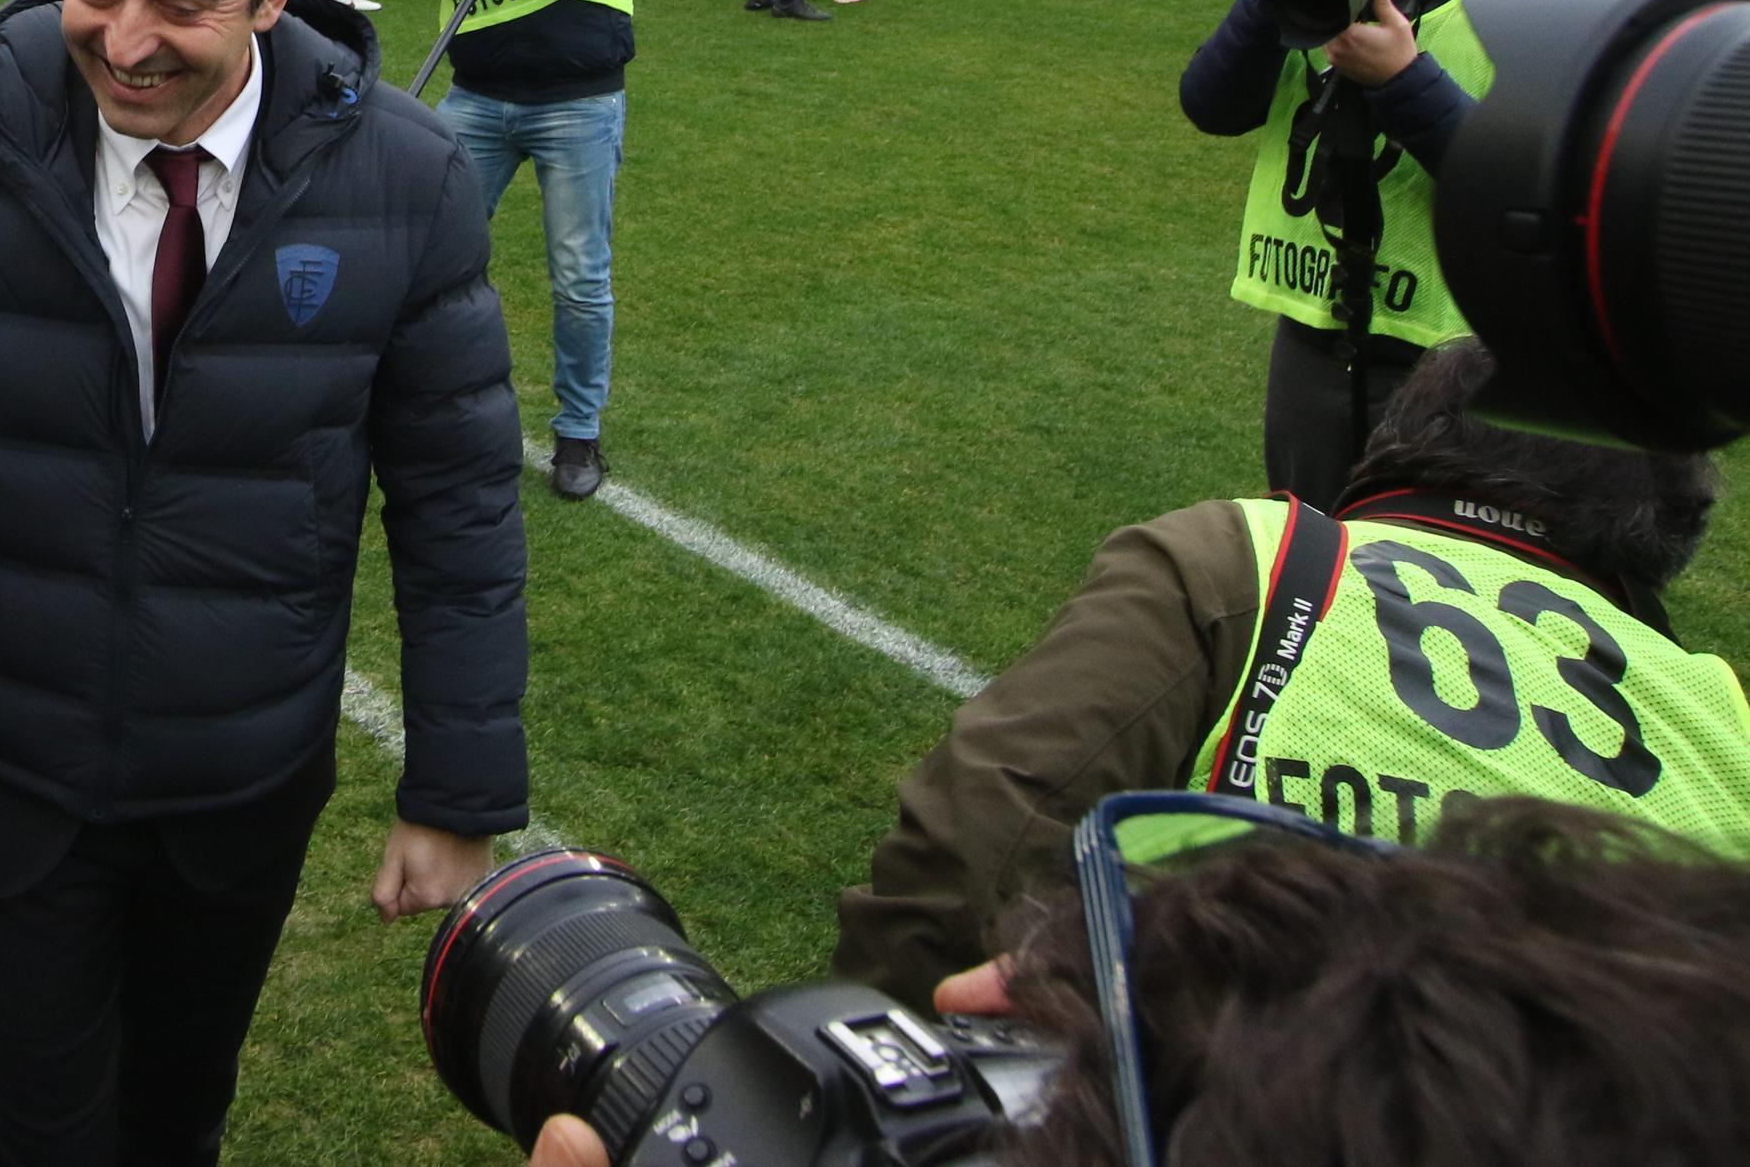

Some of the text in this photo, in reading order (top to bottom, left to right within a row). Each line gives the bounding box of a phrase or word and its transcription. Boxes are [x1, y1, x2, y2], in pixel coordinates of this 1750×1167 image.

[1454, 499, 1547, 537] anon
[1229, 710, 1267, 788] EOS
[1253, 663, 1287, 701] 7D
[1276, 610, 1309, 661] Mark
[1350, 539, 1662, 799] 63
